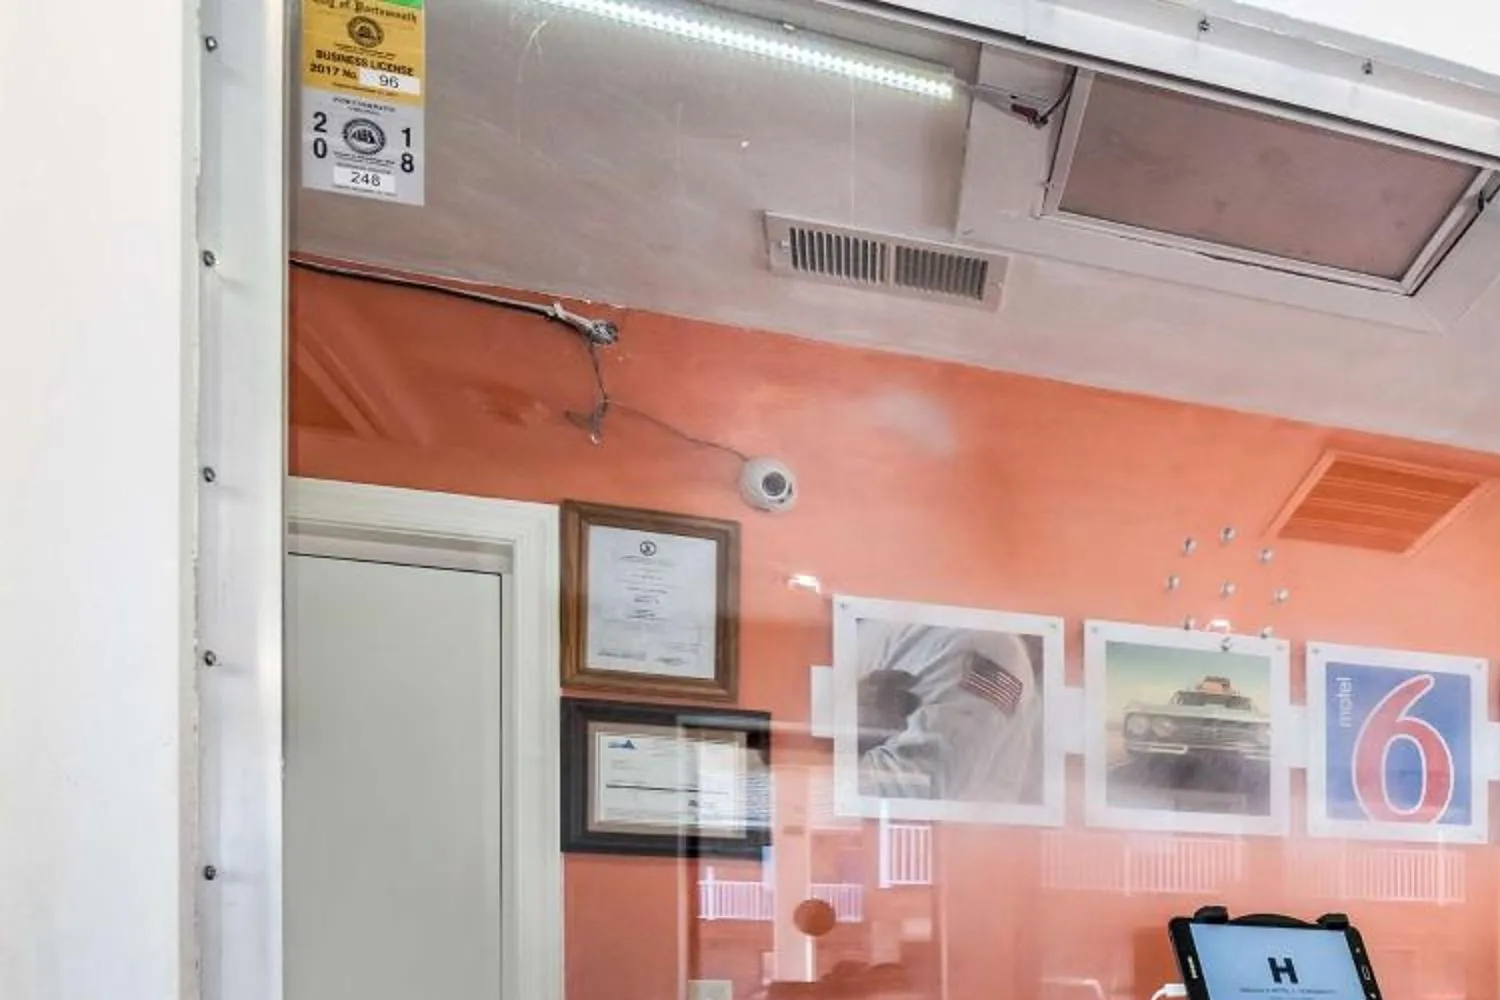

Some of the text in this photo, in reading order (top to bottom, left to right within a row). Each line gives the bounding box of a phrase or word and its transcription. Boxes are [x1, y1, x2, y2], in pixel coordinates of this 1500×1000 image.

[310, 63, 340, 77] 2017
[315, 49, 369, 67] BUSINESS
[370, 60, 415, 77] LICENSE
[379, 75, 400, 89] 96
[351, 171, 381, 187] 248
[1336, 674, 1455, 825] motel 6
[1267, 957, 1299, 984] H
